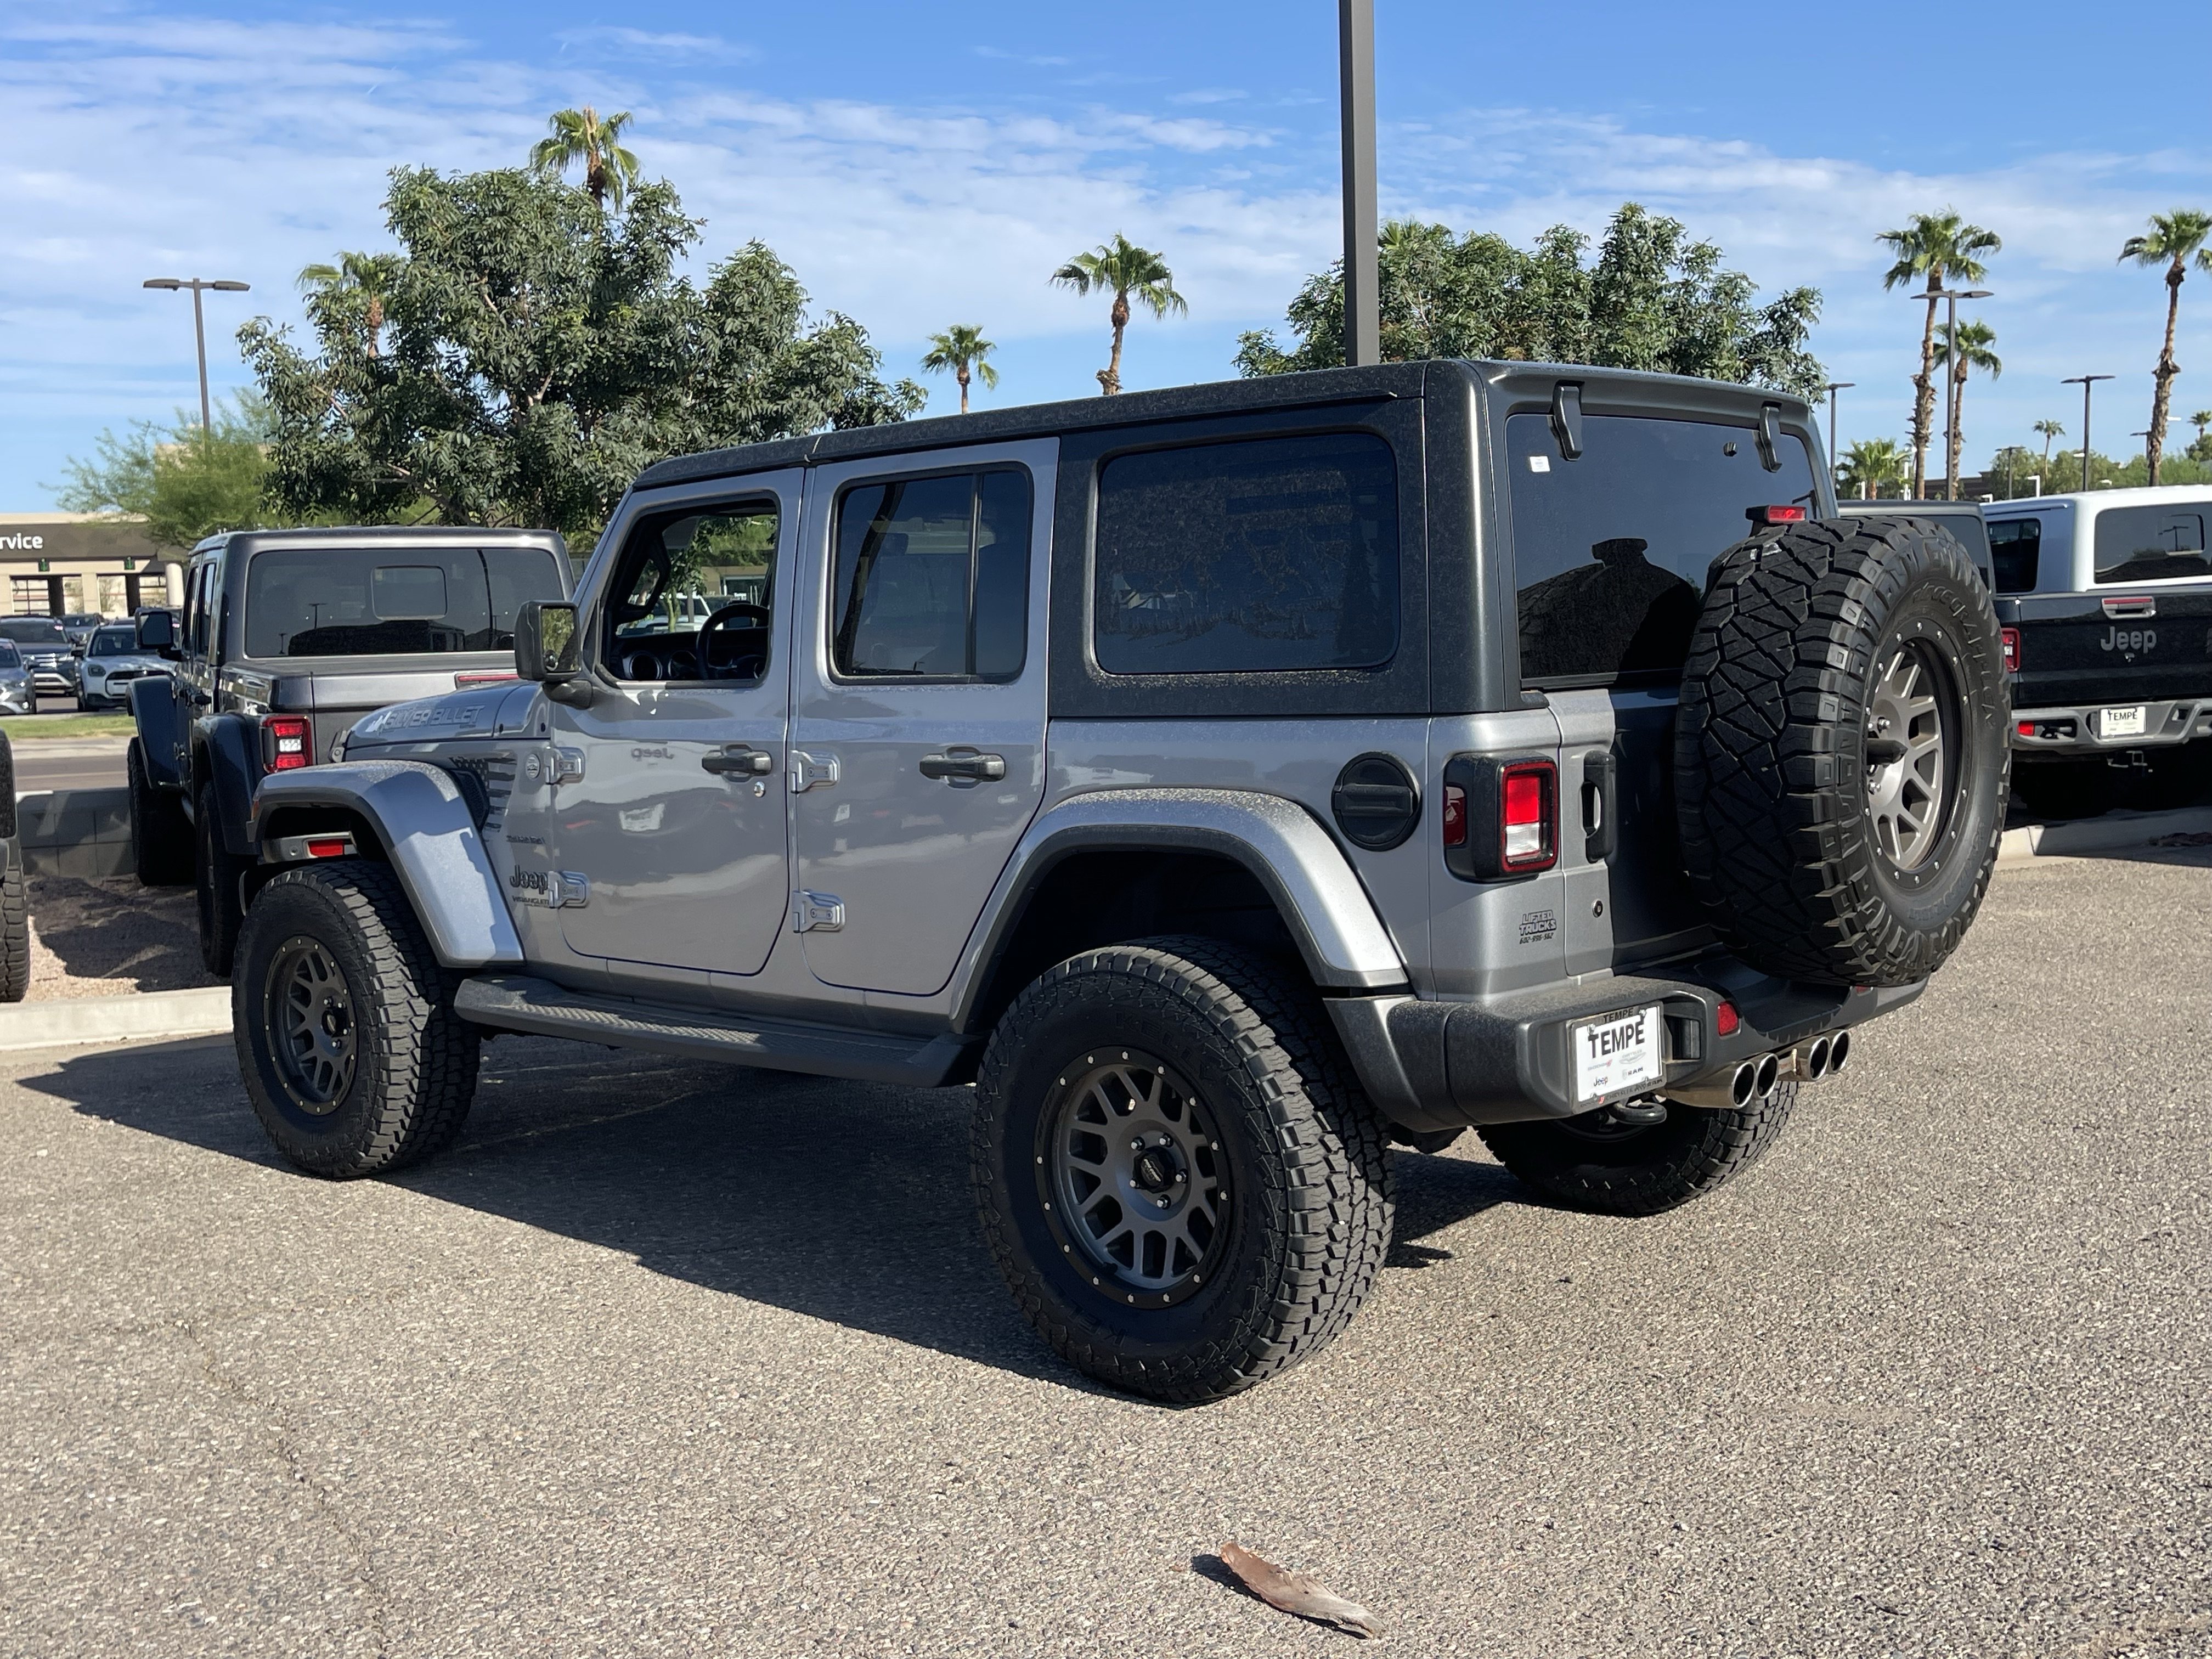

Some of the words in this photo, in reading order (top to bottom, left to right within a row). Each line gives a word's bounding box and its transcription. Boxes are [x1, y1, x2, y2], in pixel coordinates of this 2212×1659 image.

[0, 532, 43, 550] rvice
[2100, 626, 2157, 653] Jeep
[2108, 711, 2138, 721] TEMPE
[510, 865, 548, 895] Jeep
[1522, 910, 1554, 925] LIFTED
[1519, 919, 1556, 936] TRUCKS
[1603, 1007, 1634, 1023] TEMPE
[1115, 1010, 1218, 1081] KELLY
[1588, 1021, 1645, 1058] TEMPE
[1593, 1076, 1609, 1087] Jeep
